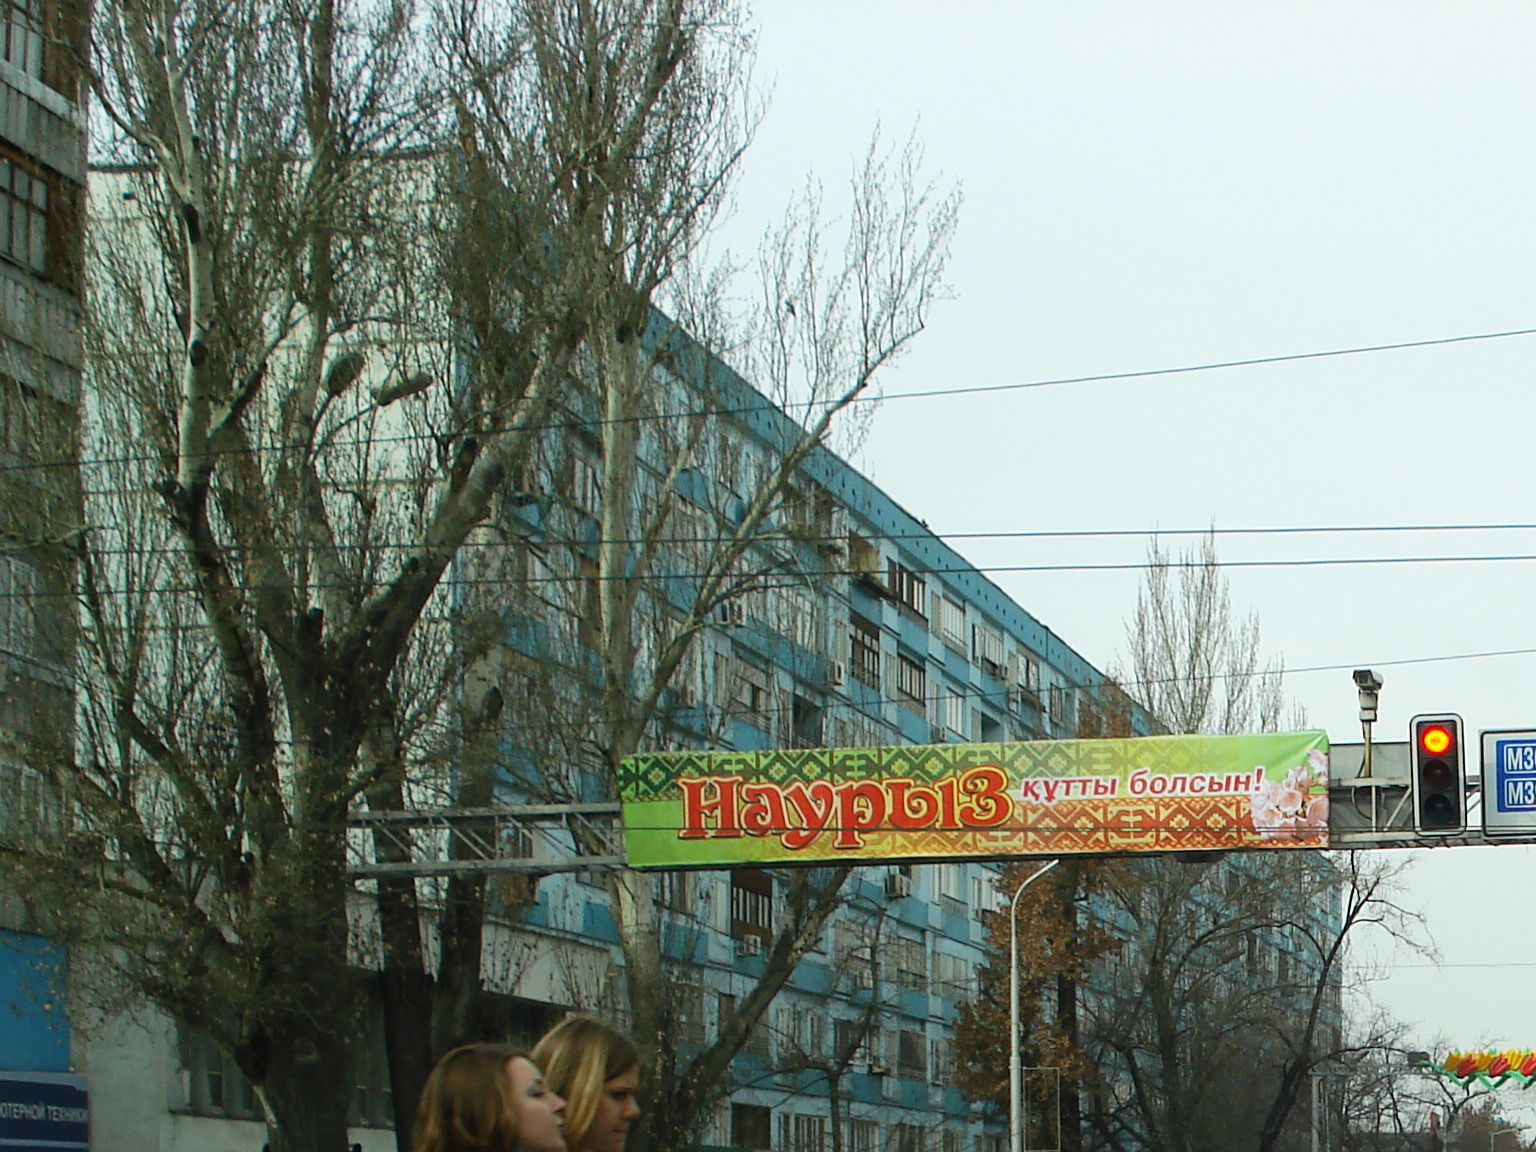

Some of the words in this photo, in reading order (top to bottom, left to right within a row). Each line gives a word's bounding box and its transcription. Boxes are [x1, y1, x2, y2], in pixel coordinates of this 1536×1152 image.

[675, 764, 1016, 850] Наурыз
[1021, 776, 1118, 803] құтты
[1129, 768, 1265, 795] болсын!
